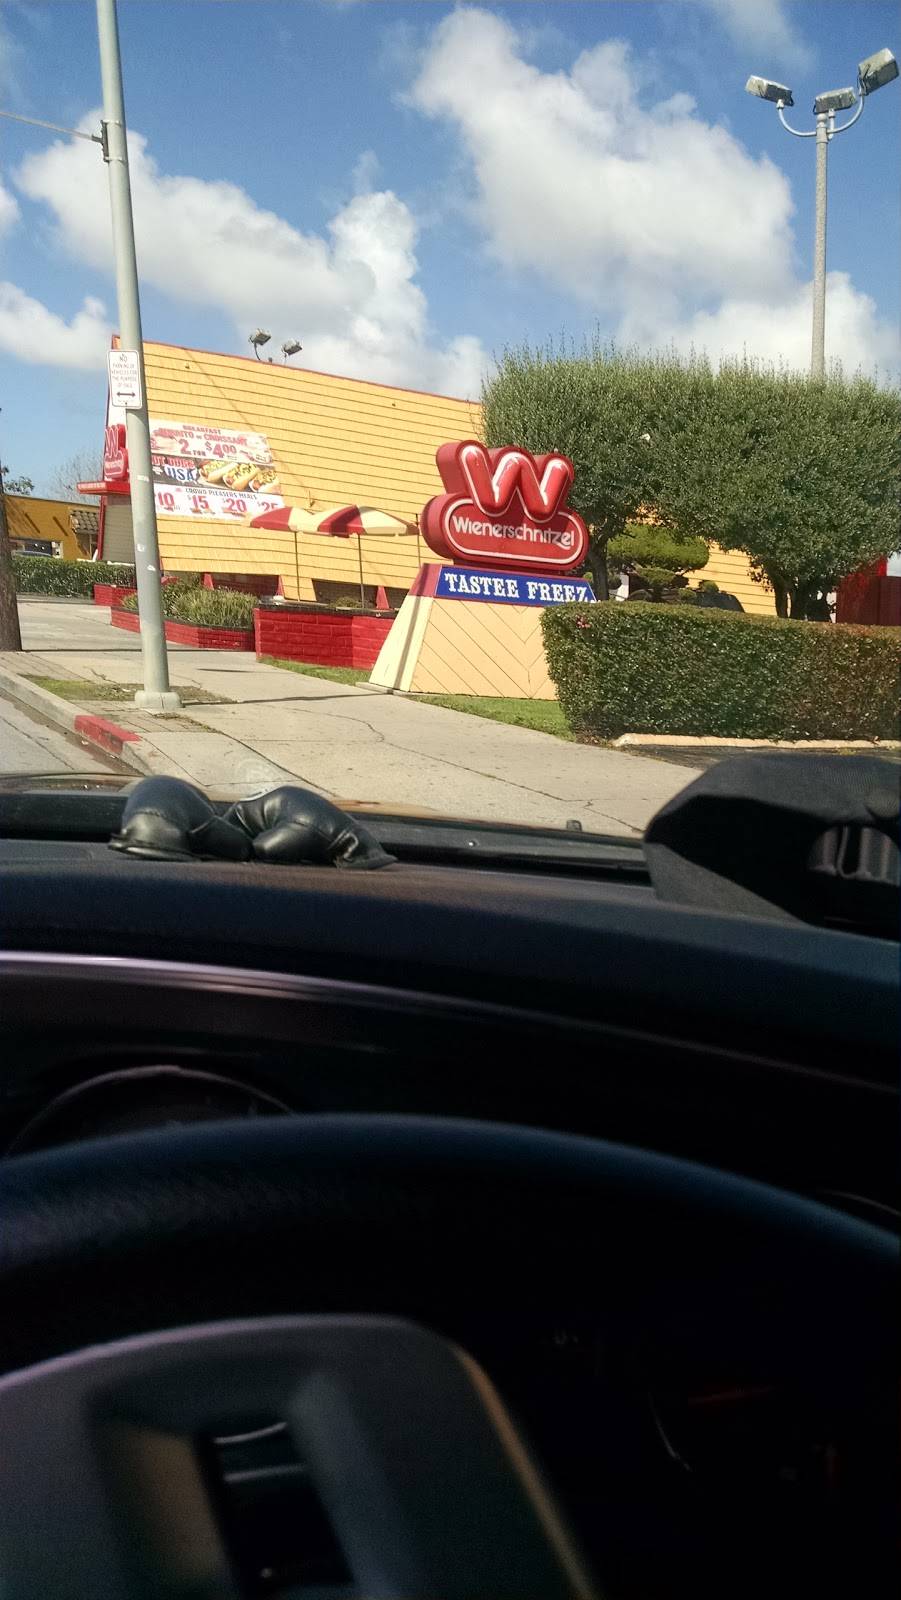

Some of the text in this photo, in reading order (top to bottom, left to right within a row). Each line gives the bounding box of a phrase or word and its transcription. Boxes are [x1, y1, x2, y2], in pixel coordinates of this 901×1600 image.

[182, 425, 221, 435] BREAKFAST
[179, 438, 192, 455] 2
[151, 455, 166, 466] OT
[167, 467, 195, 481] USA
[461, 444, 570, 524] W
[208, 490, 238, 498] PLEASERS
[238, 492, 258, 500] MEALS
[451, 515, 575, 551] Wienerschnitzel
[444, 572, 589, 603] TASTEE FREEZ
